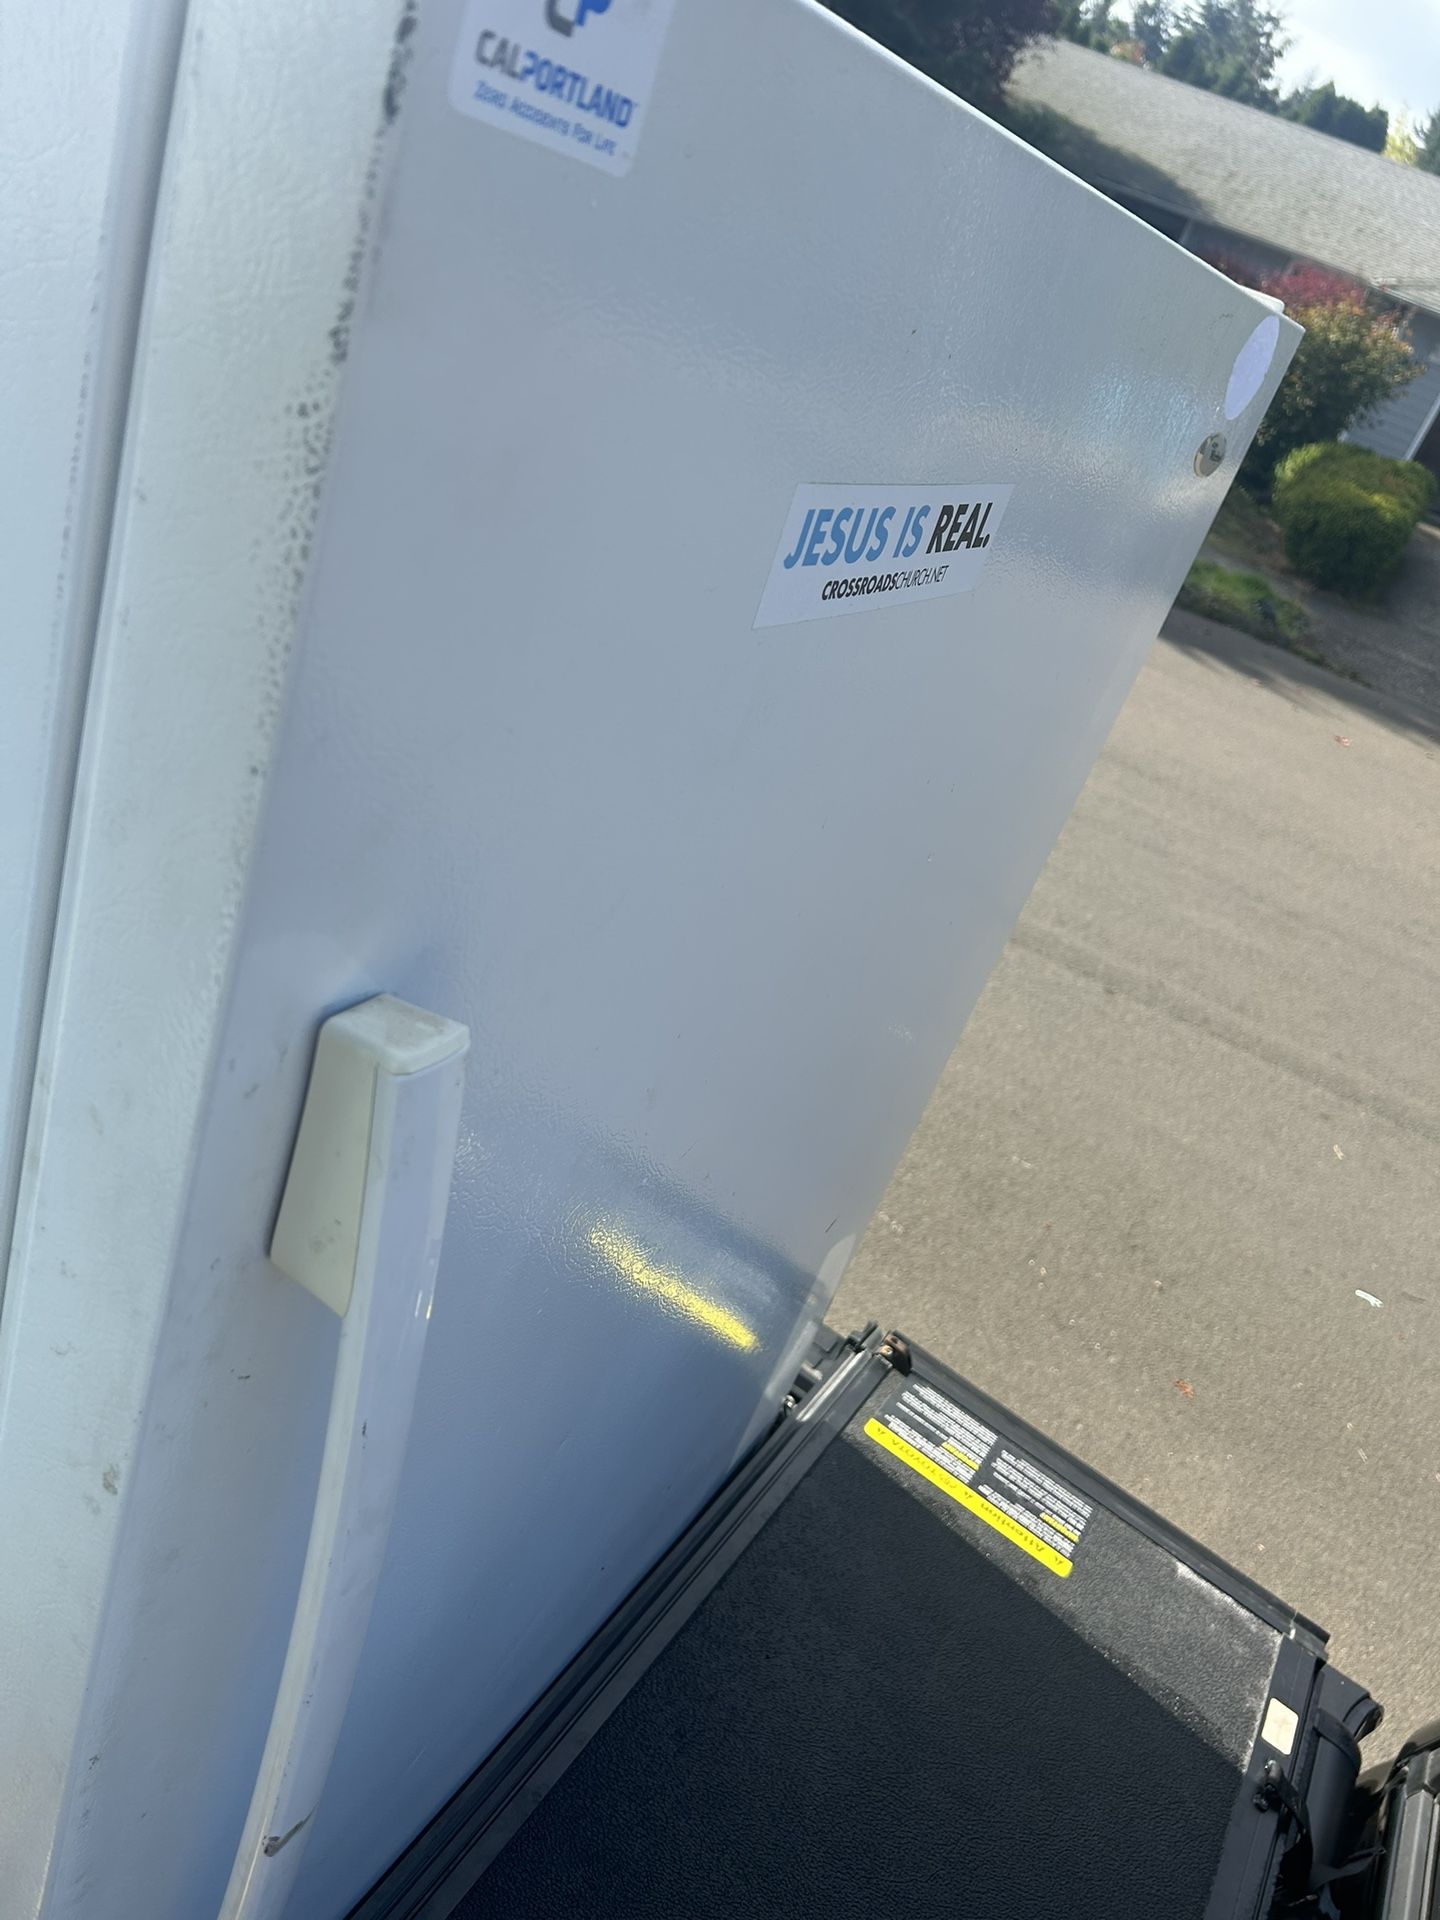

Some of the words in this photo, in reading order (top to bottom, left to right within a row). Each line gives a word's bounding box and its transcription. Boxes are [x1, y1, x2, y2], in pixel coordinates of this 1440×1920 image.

[475, 29, 634, 128] CALPORTLAND
[784, 506, 896, 570] JESUS
[893, 504, 931, 559] IS
[926, 502, 993, 554] REAL.
[821, 565, 949, 600] CROSSROADSCHURCH.NET
[979, 1502, 1044, 1551] Attention
